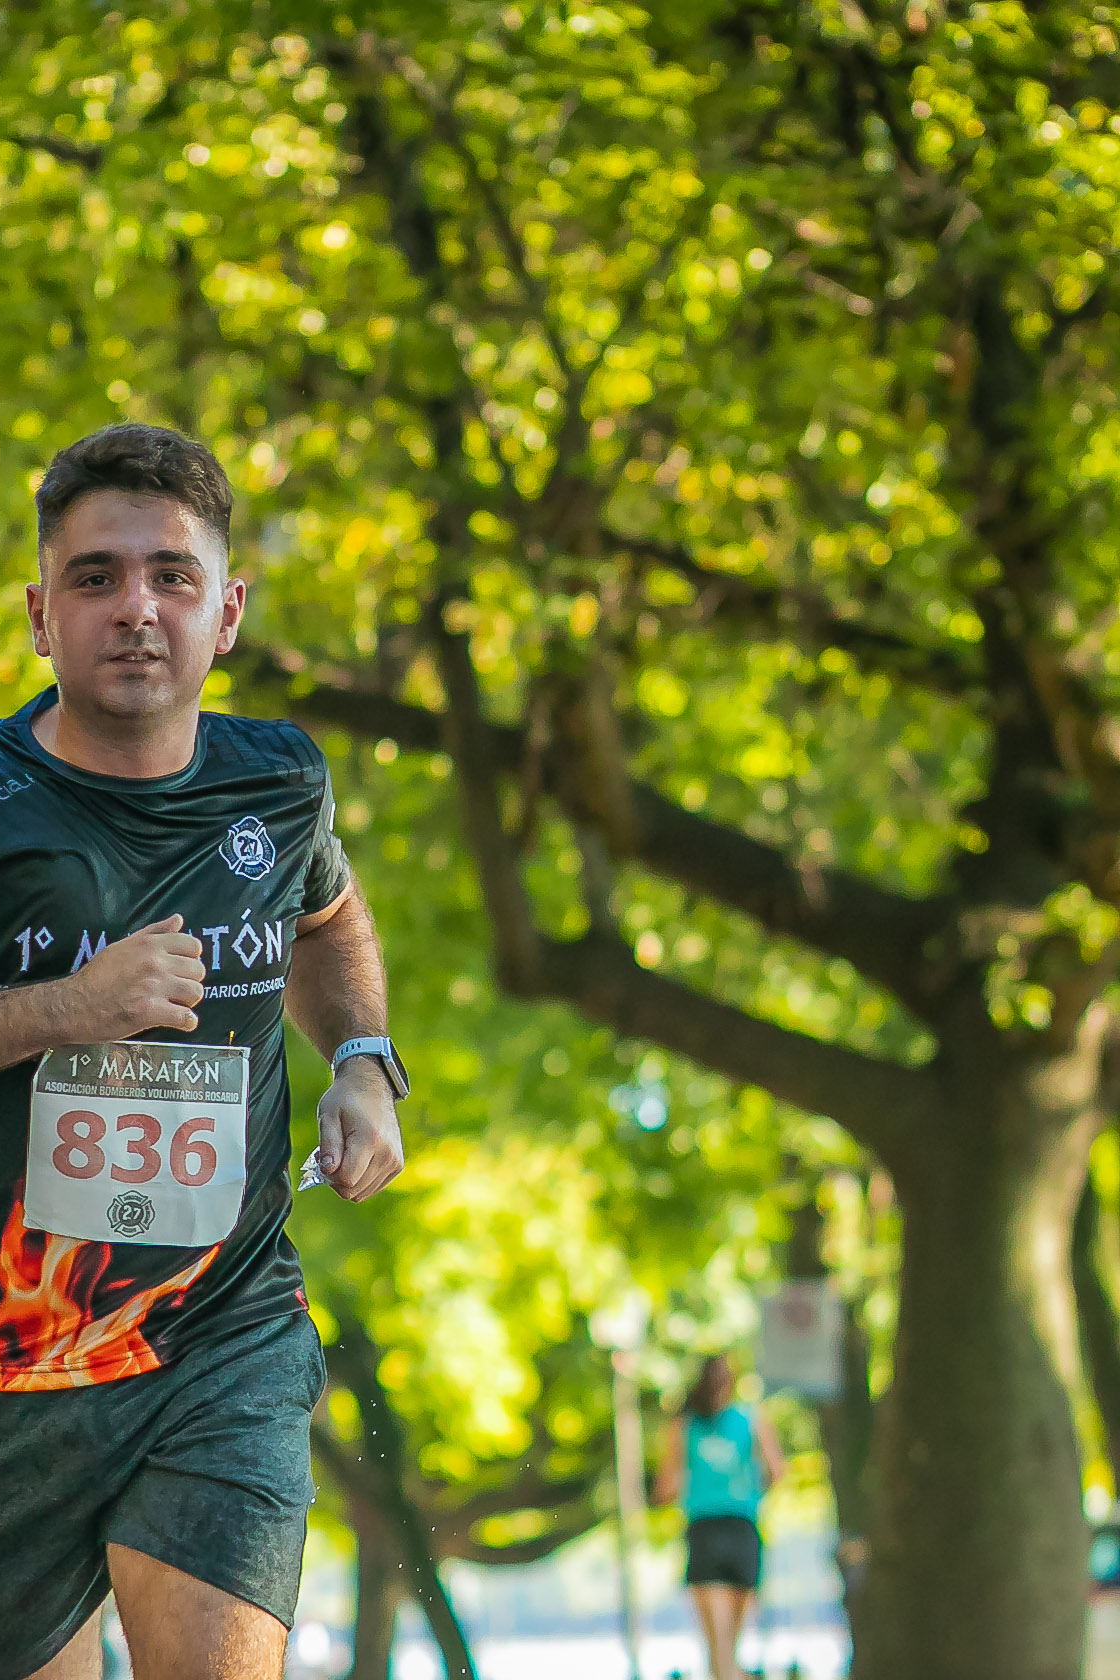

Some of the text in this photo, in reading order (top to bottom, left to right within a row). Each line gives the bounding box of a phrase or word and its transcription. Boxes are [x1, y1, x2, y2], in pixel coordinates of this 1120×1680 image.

[70, 908, 283, 973] MTÓN
[204, 984, 248, 999] TARIOS
[98, 1052, 220, 1085] MARATÓN
[45, 1081, 239, 1102] ASOCIACIÓN BOMBEROS VOLUNTARIOS ROSARIO
[51, 1109, 218, 1187] 836
[122, 1204, 141, 1220] 27
